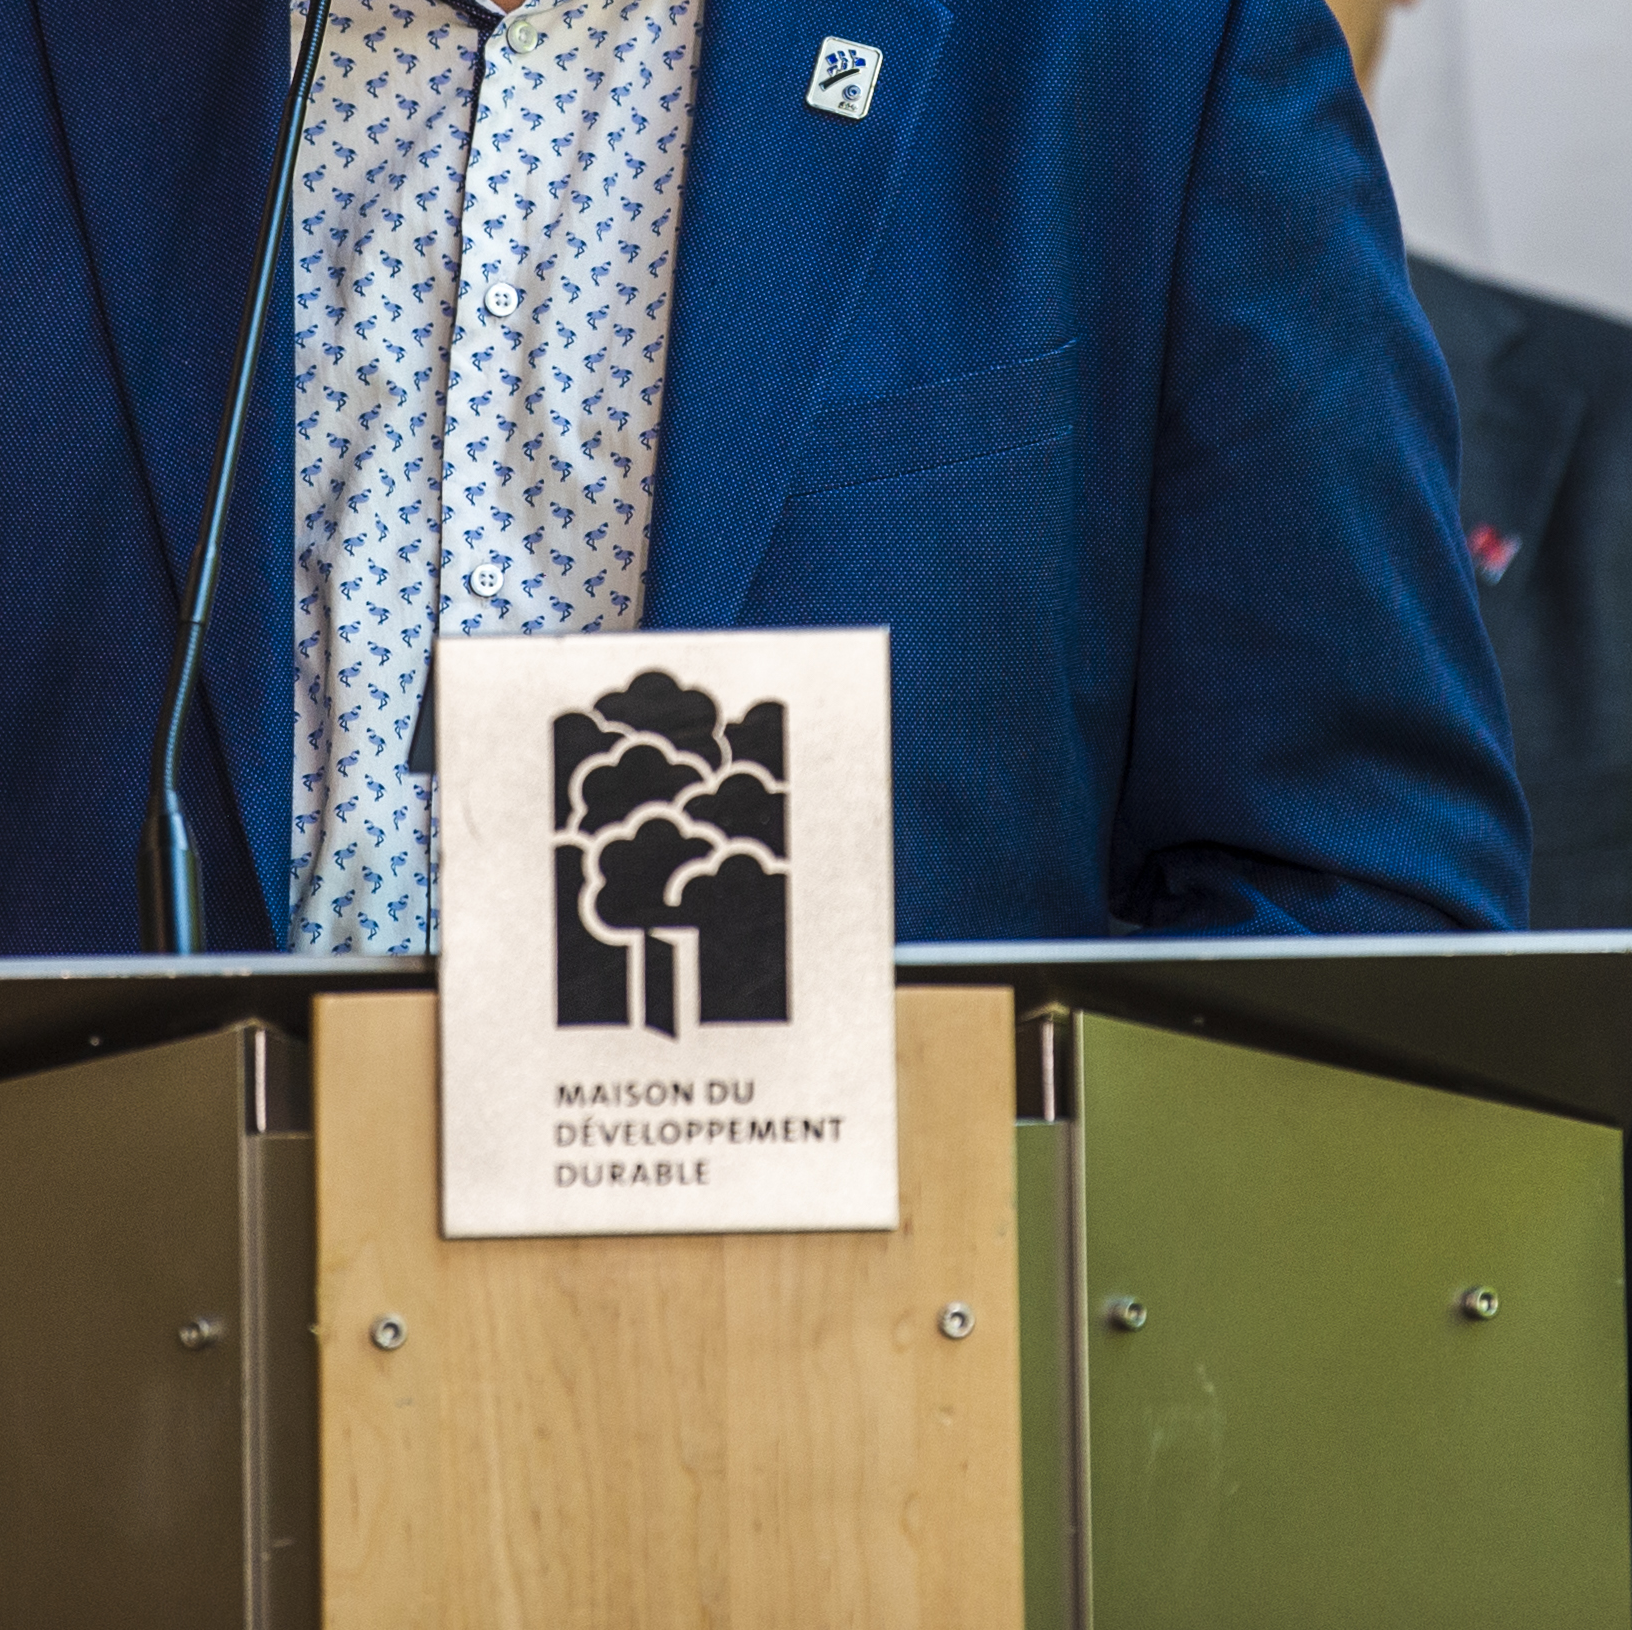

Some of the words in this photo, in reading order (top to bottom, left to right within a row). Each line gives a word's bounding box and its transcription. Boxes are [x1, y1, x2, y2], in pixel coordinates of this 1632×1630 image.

[554, 1079, 695, 1108] MAISON
[706, 1079, 756, 1106] DU
[554, 1115, 847, 1149] DÉVELOPPEMENT
[554, 1158, 711, 1189] DURABLE
